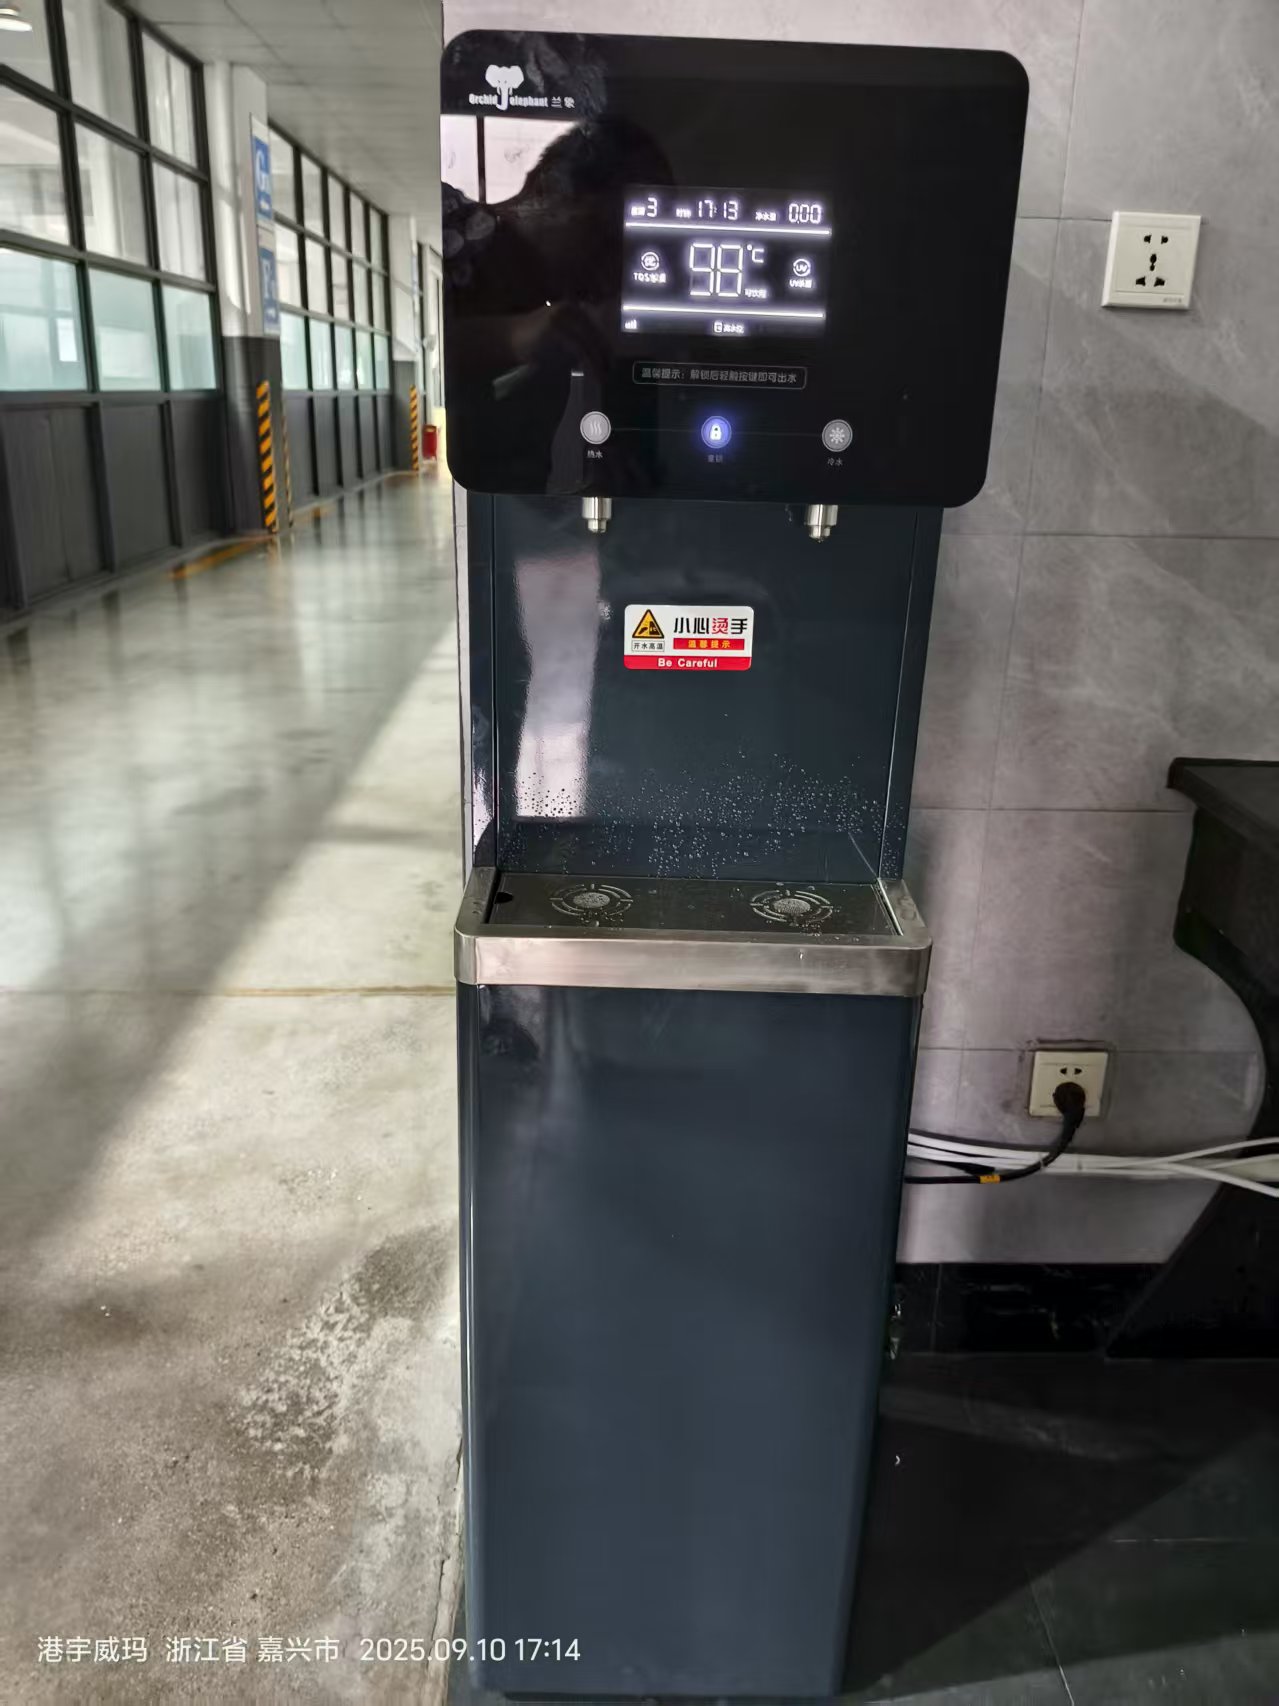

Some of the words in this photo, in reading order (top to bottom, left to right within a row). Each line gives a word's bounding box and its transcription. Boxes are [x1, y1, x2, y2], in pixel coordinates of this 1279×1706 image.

[509, 95, 548, 108] elephant
[673, 617, 748, 635] 小心烫手
[633, 642, 663, 650] 开水高温
[688, 640, 731, 649] 温馨提示
[658, 658, 672, 667] Be
[677, 658, 718, 668] Careful
